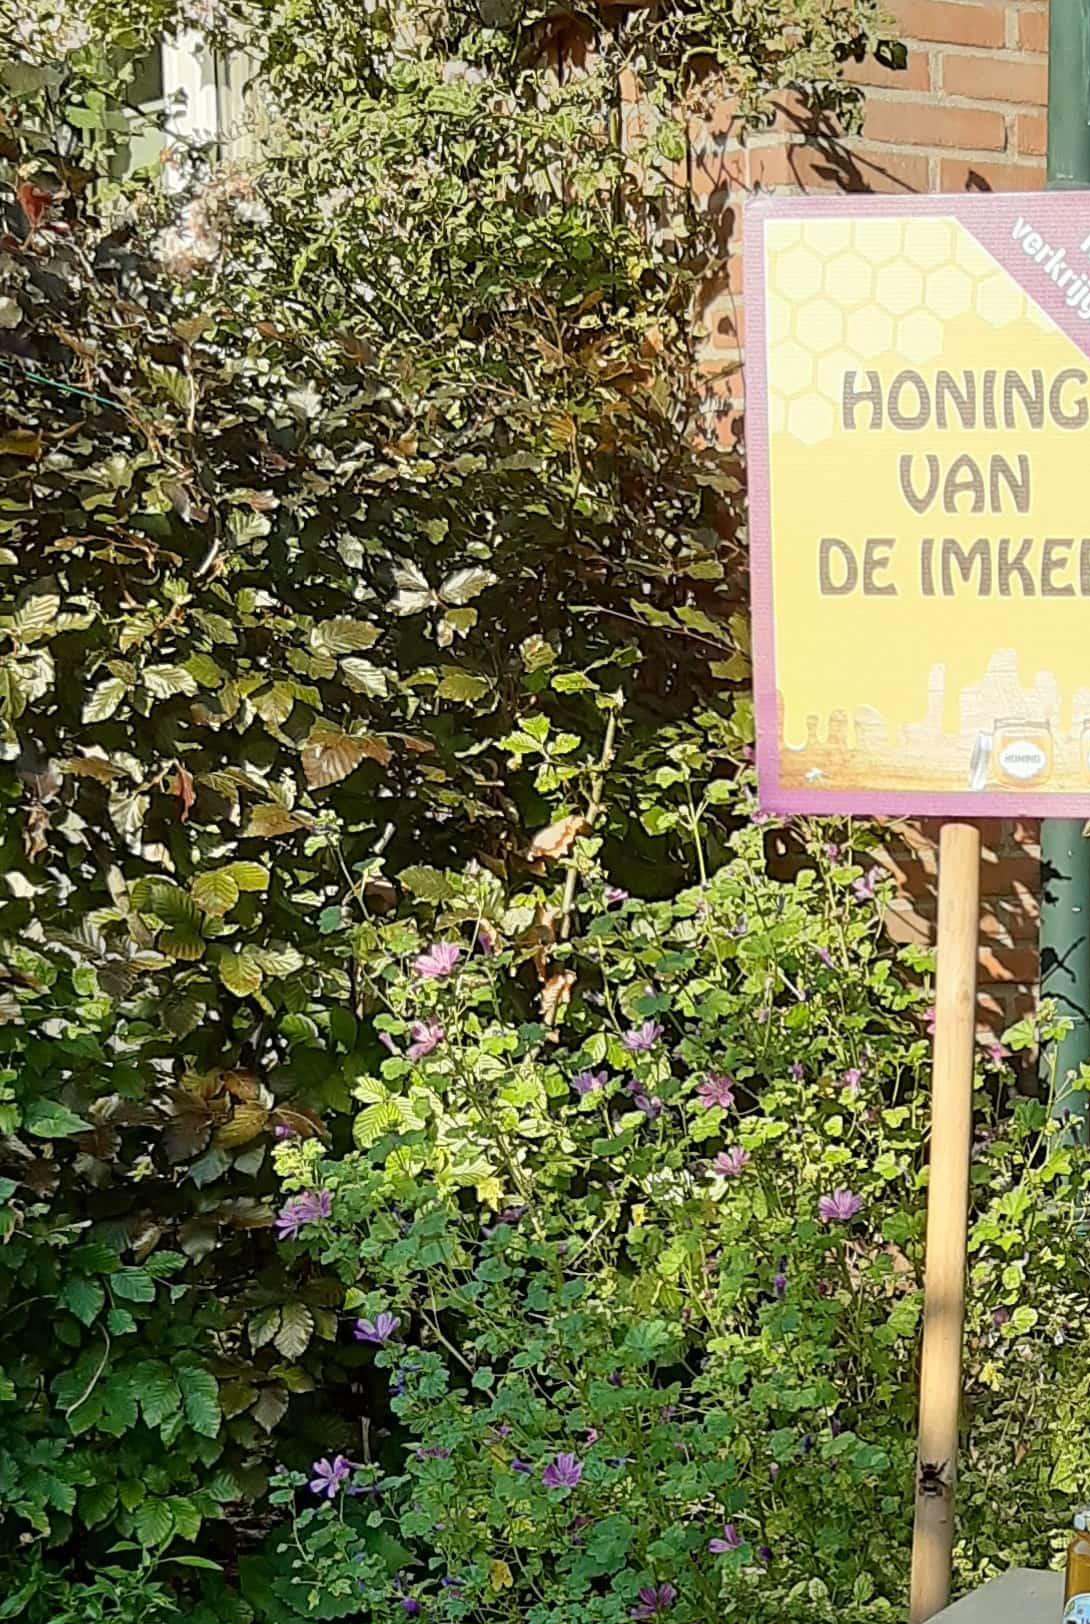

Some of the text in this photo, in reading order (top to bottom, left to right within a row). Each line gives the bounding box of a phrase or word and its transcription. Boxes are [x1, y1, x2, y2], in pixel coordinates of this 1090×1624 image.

[842, 369, 1090, 430] HONING
[898, 454, 1031, 515] VAN
[818, 538, 899, 596] DE
